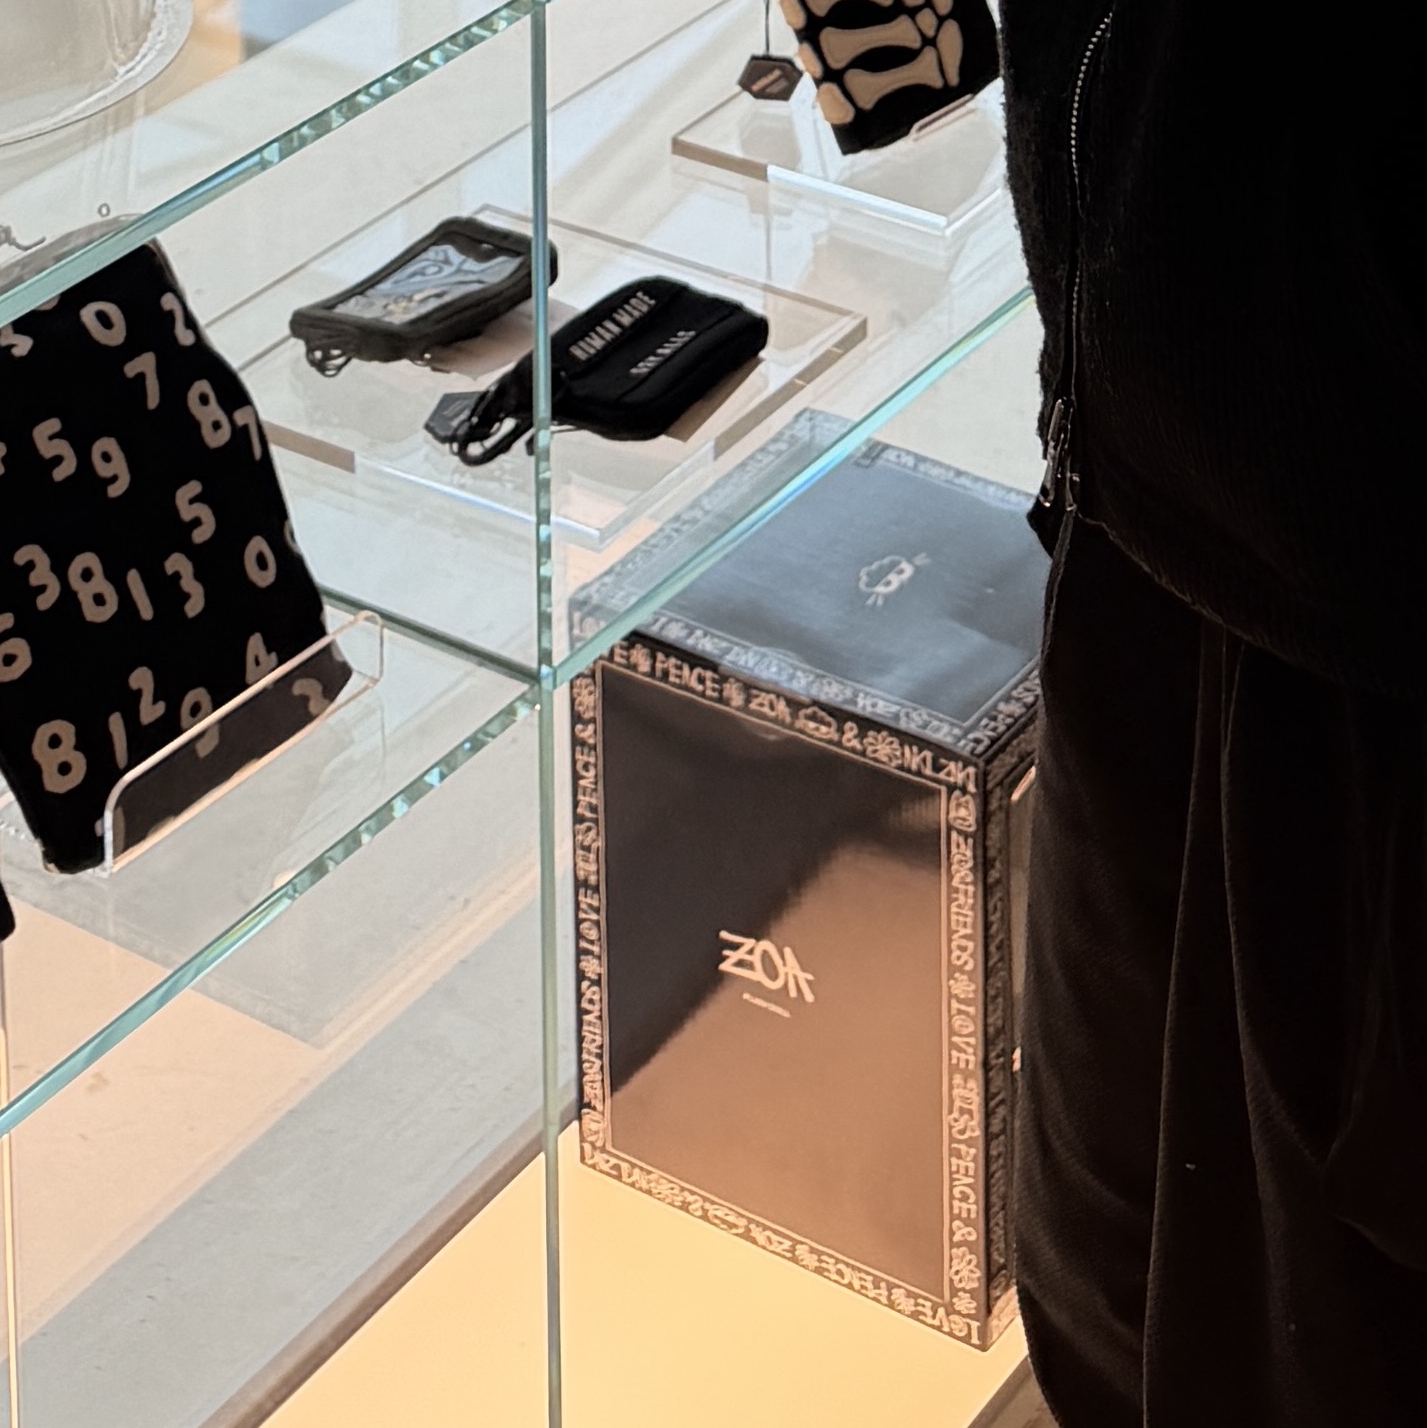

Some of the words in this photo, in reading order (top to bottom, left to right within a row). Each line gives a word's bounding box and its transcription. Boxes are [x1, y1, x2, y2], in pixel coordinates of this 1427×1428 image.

[187, 379, 232, 448] 8
[32, 417, 77, 482] 5
[91, 437, 131, 498] 9
[175, 480, 216, 544] 5
[13, 544, 61, 611] 3
[67, 551, 118, 623] 8
[164, 552, 205, 618] 3
[243, 536, 277, 588] 0
[128, 666, 166, 725] 2
[31, 719, 87, 794] 8
[950, 998, 976, 1070] LOVE
